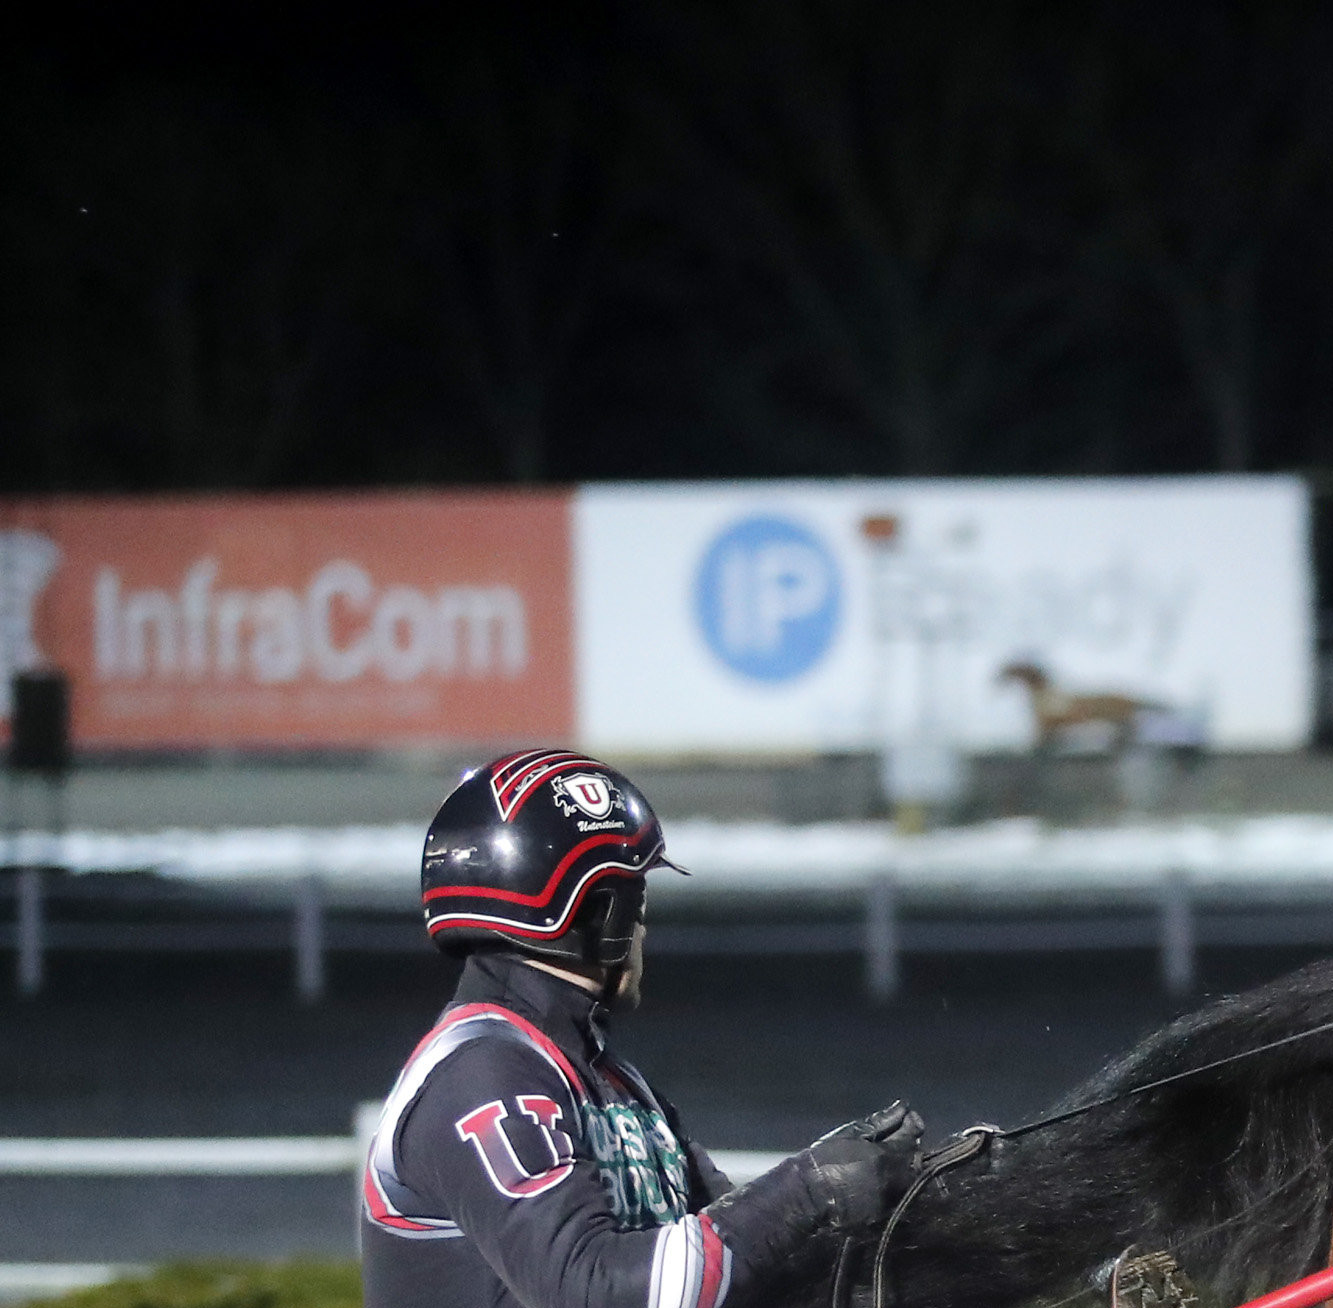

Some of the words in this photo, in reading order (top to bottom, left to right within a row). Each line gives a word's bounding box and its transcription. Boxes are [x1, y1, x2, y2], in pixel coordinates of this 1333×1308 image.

[92, 556, 530, 682] InfraCom
[716, 540, 832, 656] IP
[576, 783, 602, 804] U
[455, 1095, 576, 1199] U
